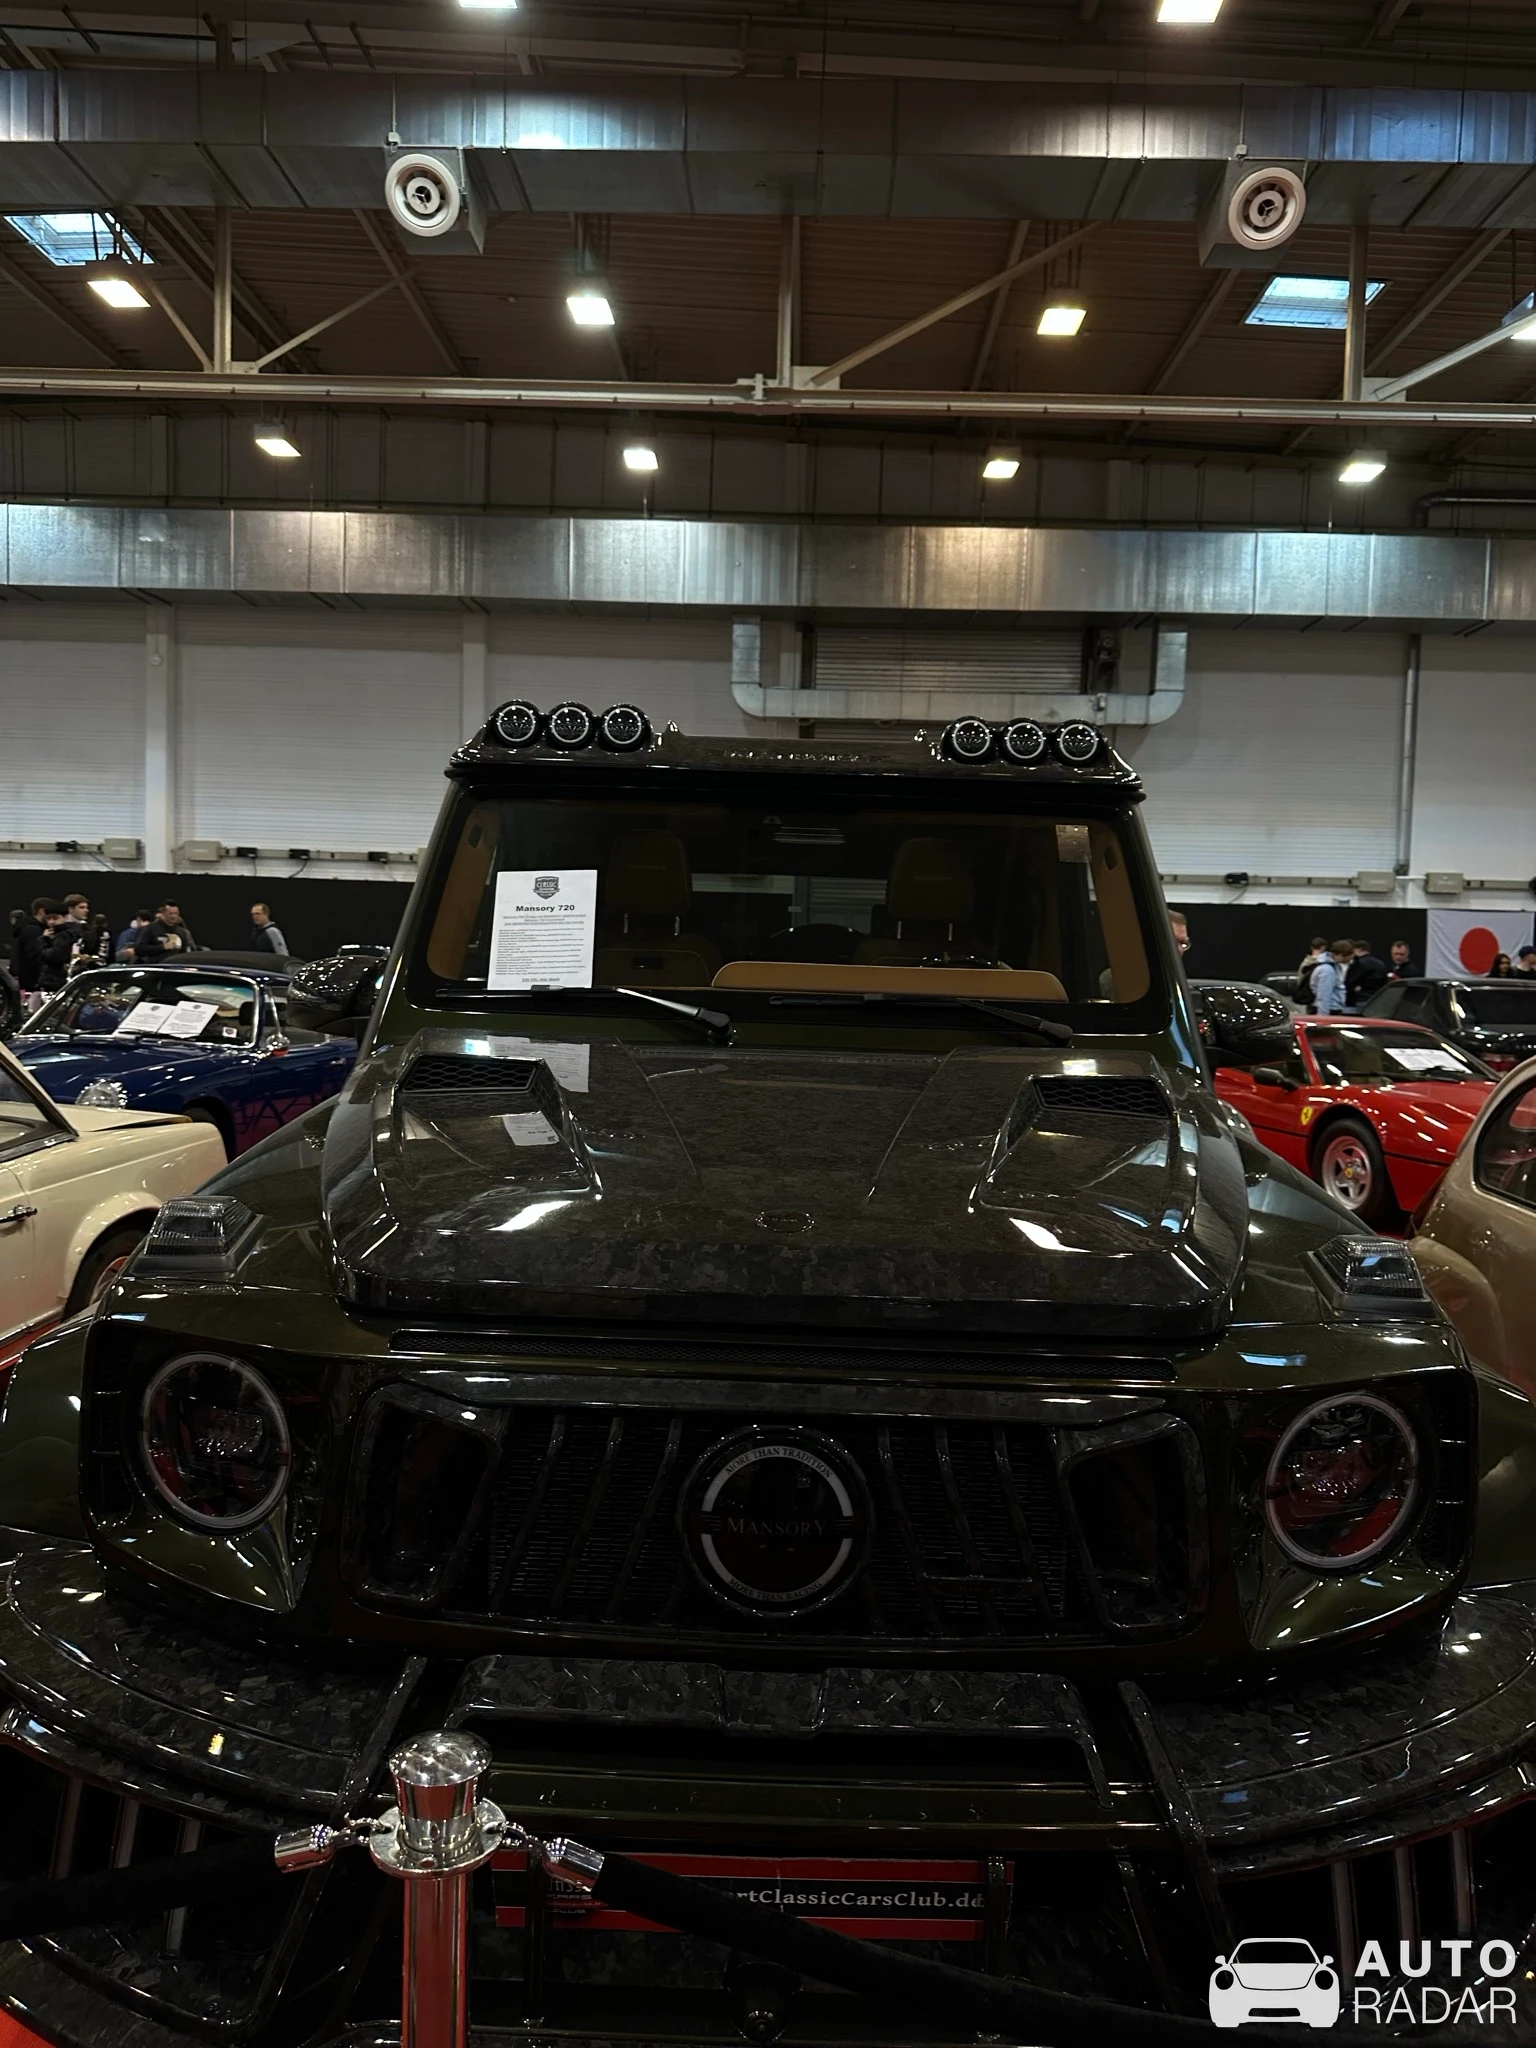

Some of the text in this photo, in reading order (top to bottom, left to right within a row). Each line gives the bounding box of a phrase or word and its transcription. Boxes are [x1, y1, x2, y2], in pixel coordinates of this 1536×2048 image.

[726, 1447, 832, 1478] MORE THAN TRADITION
[727, 1517, 826, 1537] MANSORY
[728, 1578, 754, 1597] MORE
[785, 1581, 822, 1601] RACING
